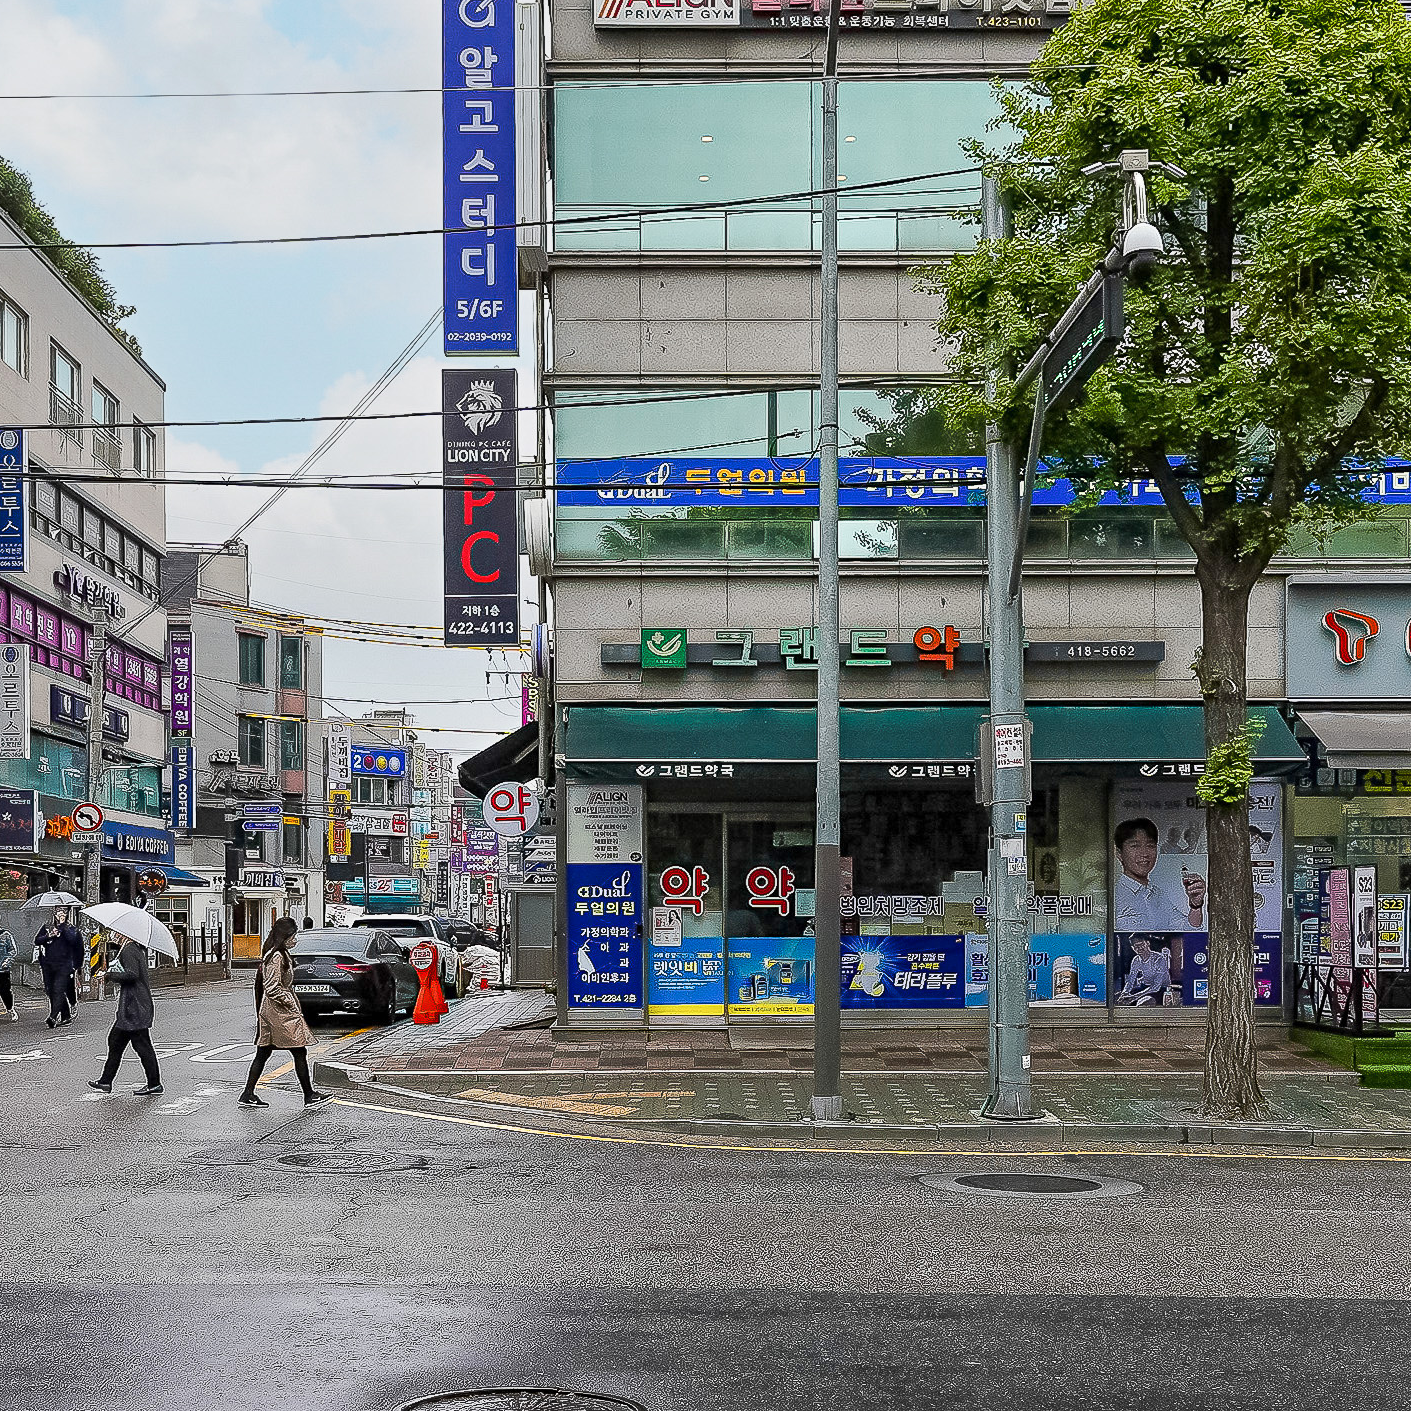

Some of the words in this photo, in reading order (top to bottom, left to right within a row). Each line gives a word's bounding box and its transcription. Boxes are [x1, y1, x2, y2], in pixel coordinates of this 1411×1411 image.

[626, 10, 693, 19] PRIVATE
[701, 10, 733, 19] GYM
[460, 47, 498, 285] 알고스터디
[458, 299, 502, 319] 5/6F
[448, 333, 511, 341] 02-2039-0192
[448, 450, 478, 462] LION
[480, 449, 510, 461] CITY
[461, 474, 500, 583] PC
[462, 606, 481, 616] 지하
[485, 605, 500, 616] 1층
[449, 622, 513, 634] 422-4113
[1068, 646, 1134, 656] 418-5662
[1, 663, 21, 736] 오르투스
[659, 765, 734, 777] 그랜드약국
[179, 784, 189, 828] COFFEE
[488, 784, 531, 831] 약
[126, 835, 144, 851] EDIYA
[660, 866, 709, 916] 약
[746, 866, 795, 916] 약
[575, 902, 634, 915] 두얼의원
[840, 896, 944, 917] 병원처방조제
[581, 927, 629, 937] 가정의학과
[654, 961, 697, 976] 렛잇비
[894, 972, 957, 989] 테라플루
